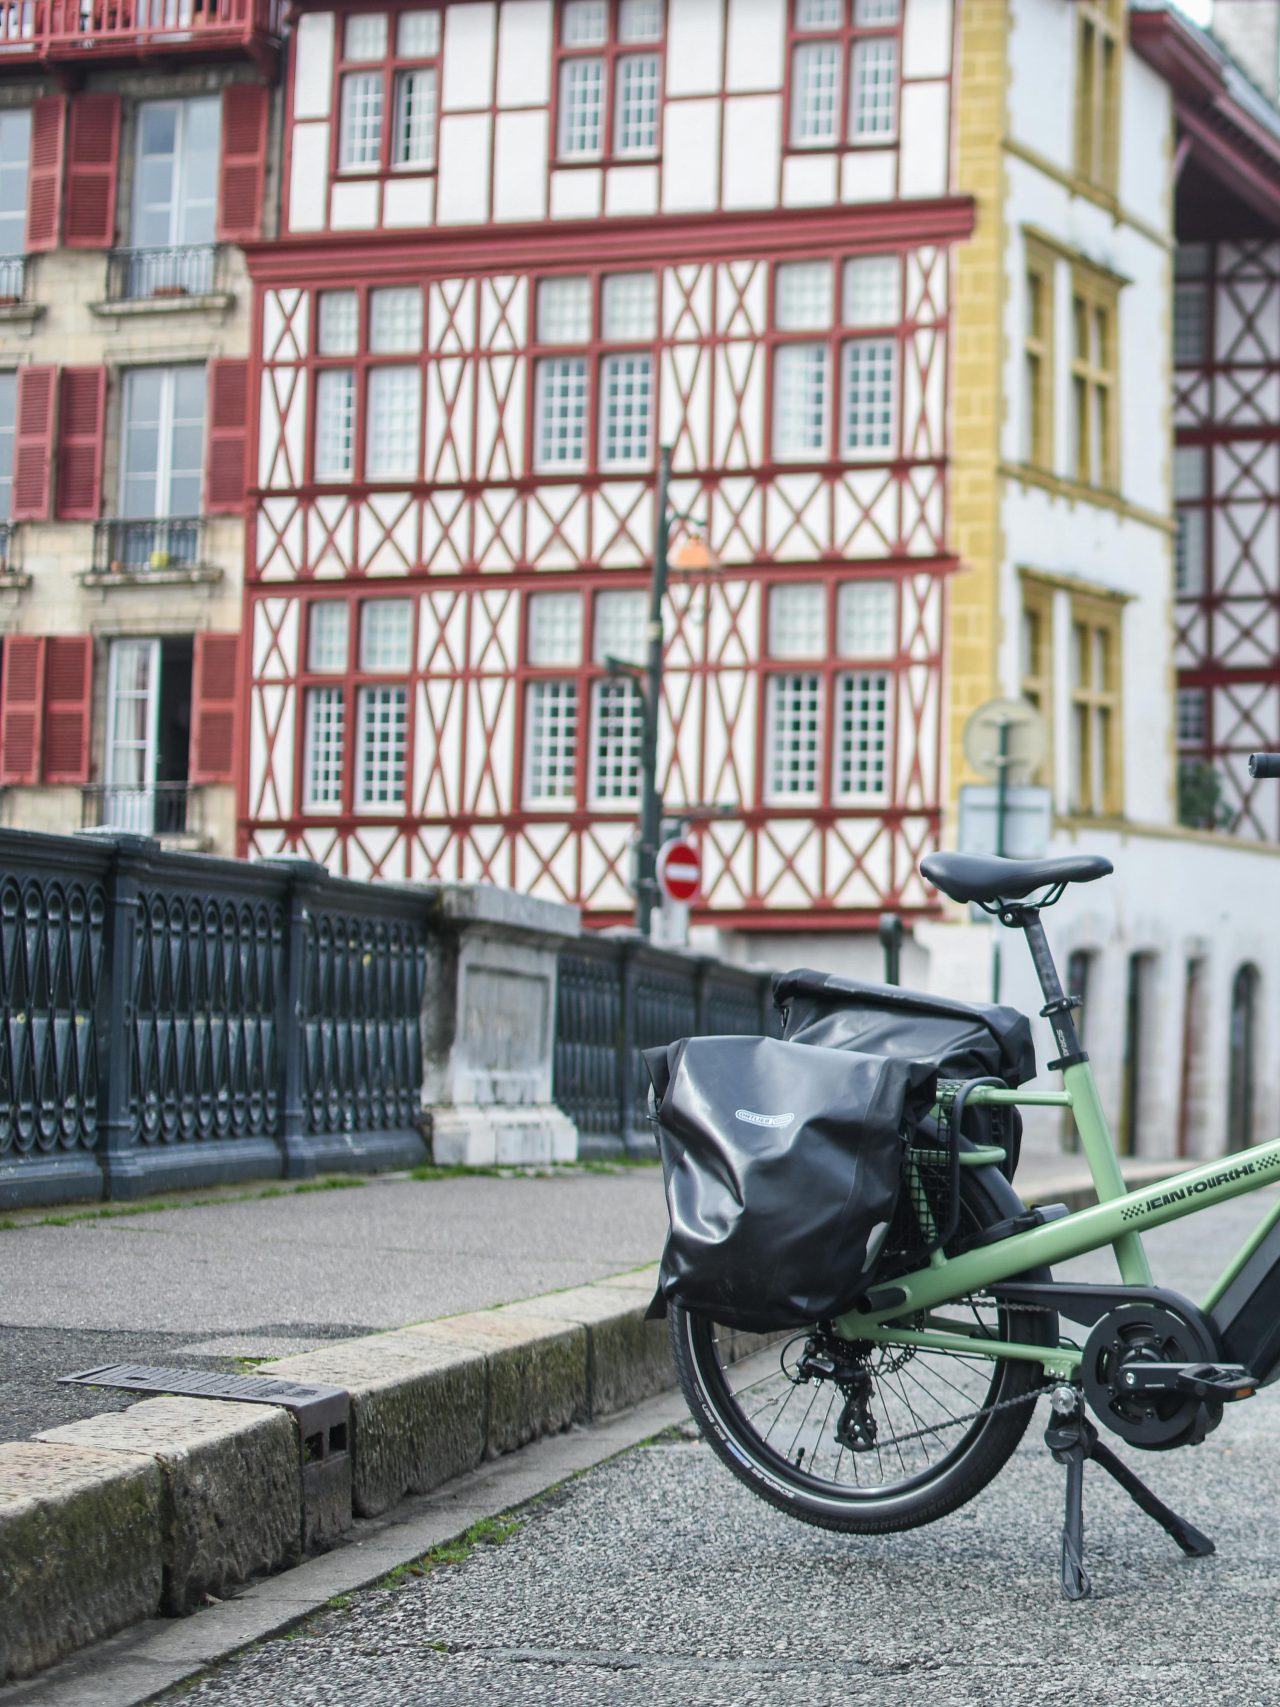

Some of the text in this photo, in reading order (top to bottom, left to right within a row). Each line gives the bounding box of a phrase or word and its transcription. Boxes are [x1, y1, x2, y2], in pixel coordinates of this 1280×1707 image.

[739, 1111, 773, 1125] ORTLIEB
[1147, 1163, 1255, 1212] JEAN FOURCHE
